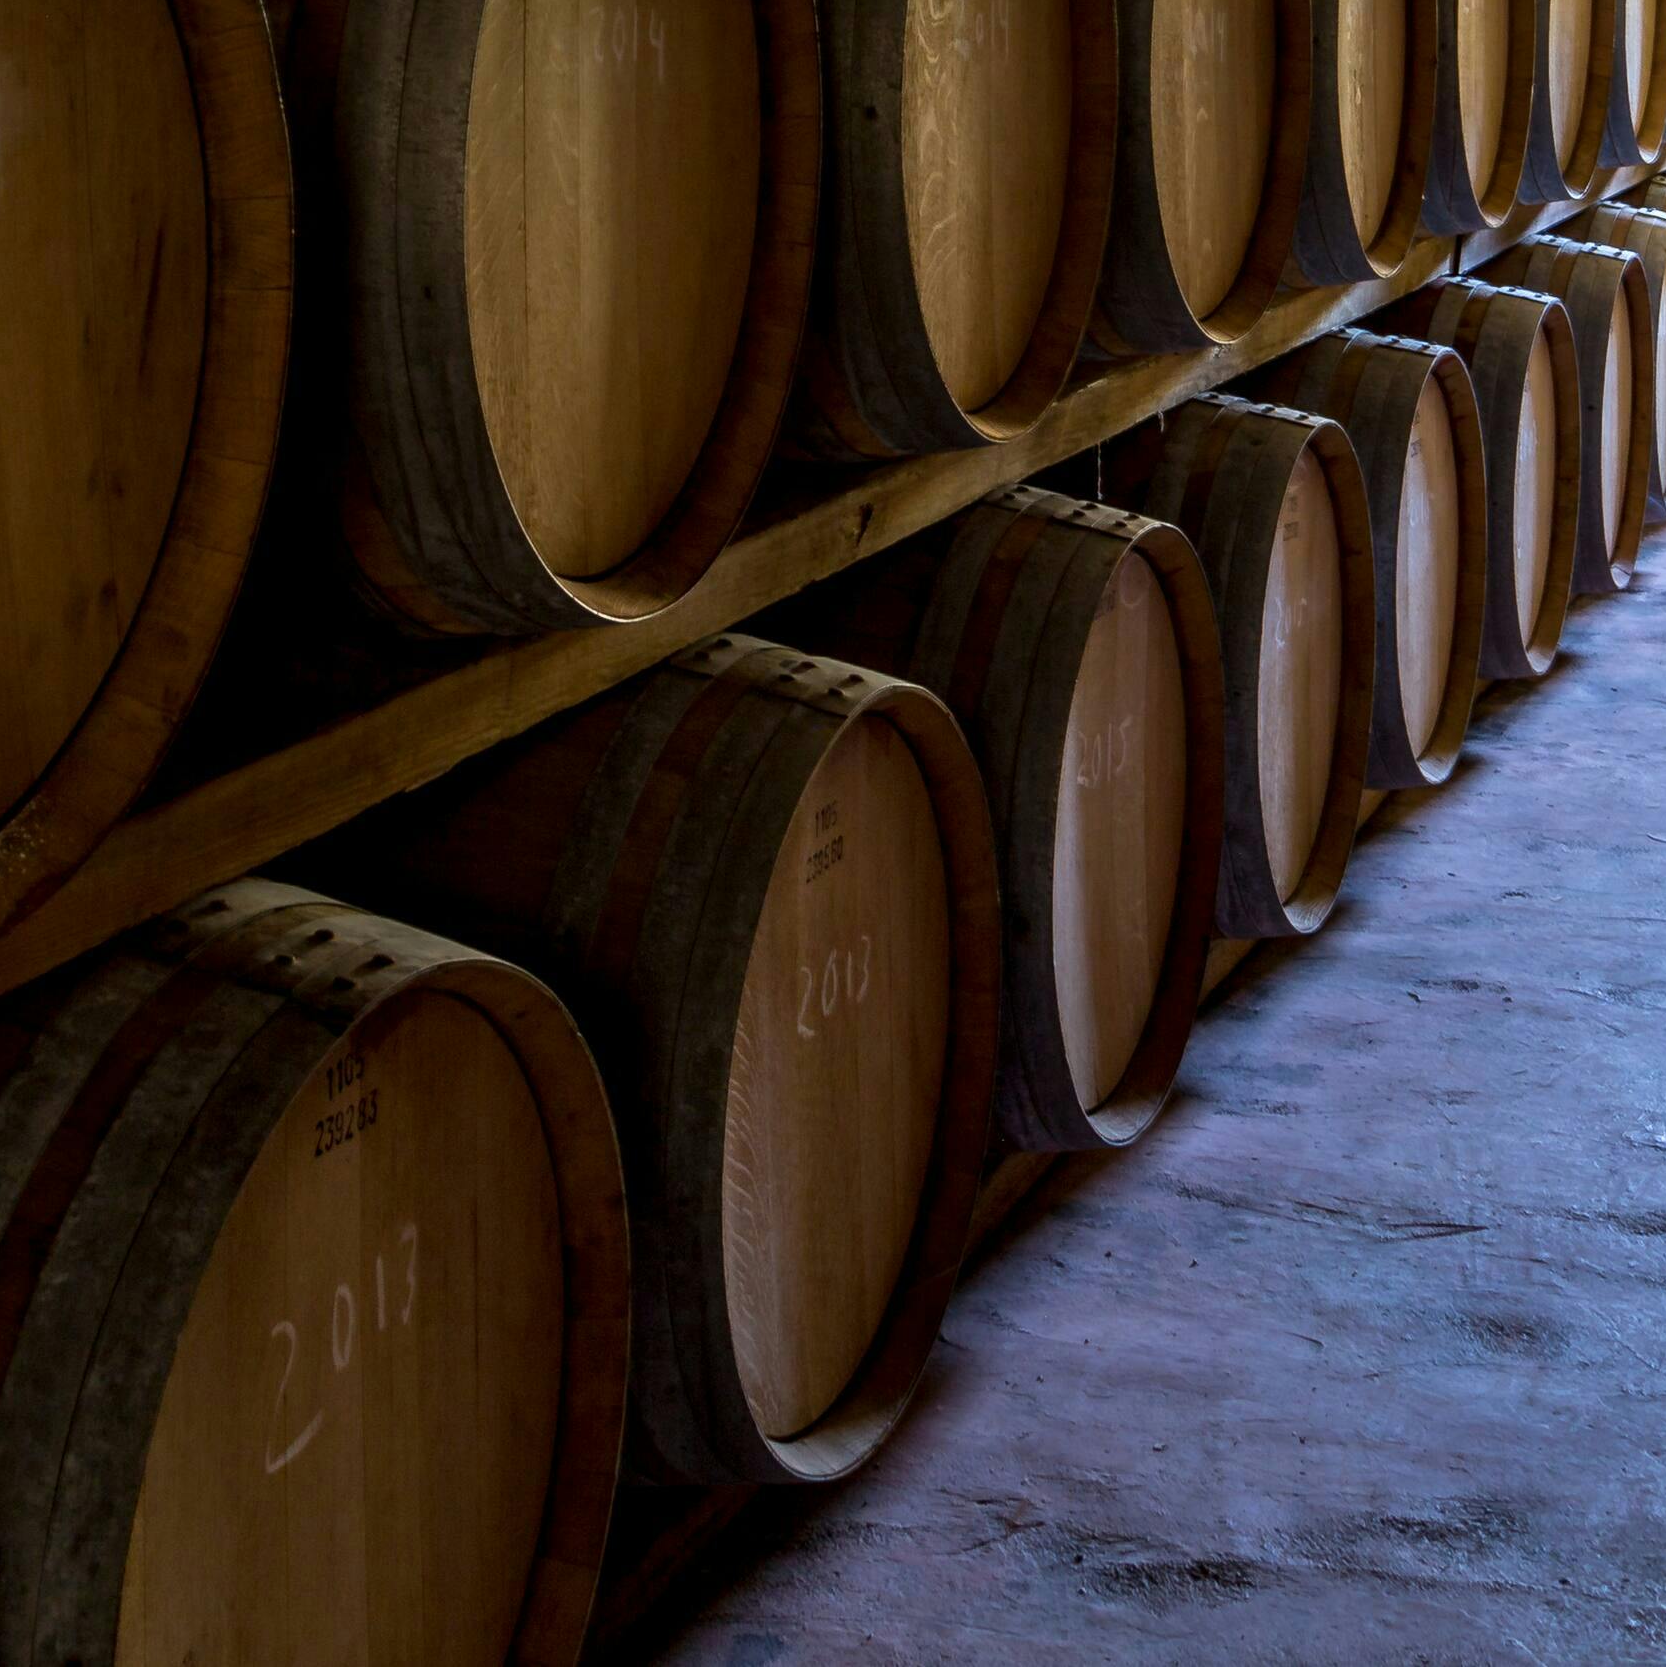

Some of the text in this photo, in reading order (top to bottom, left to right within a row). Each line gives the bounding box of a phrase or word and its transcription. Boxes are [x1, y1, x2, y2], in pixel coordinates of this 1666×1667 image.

[587, 4, 666, 85] 2014
[796, 934, 871, 1039] 2013
[326, 1052, 365, 1102] 1105
[313, 1087, 379, 1159] 239283
[264, 1220, 418, 1475] 2013
